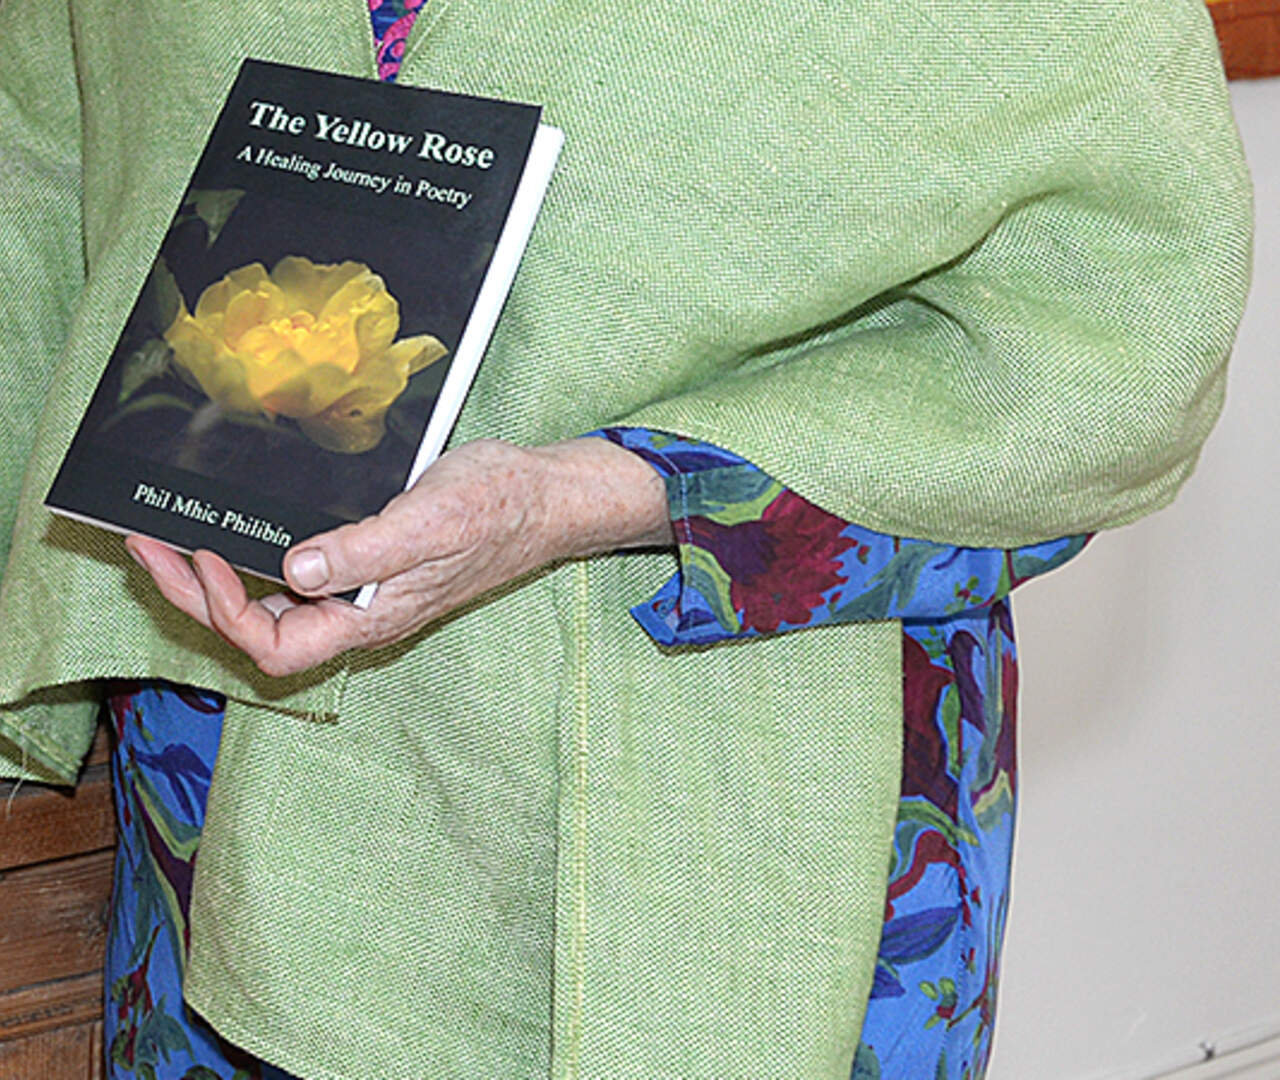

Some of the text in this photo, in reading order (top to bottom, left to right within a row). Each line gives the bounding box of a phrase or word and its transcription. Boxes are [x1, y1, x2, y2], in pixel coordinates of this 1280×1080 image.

[250, 101, 494, 169] The Yellow Rose
[236, 145, 473, 210] A Healing Journey in Poetry
[133, 484, 172, 509] Phil
[170, 495, 219, 524] Mhic
